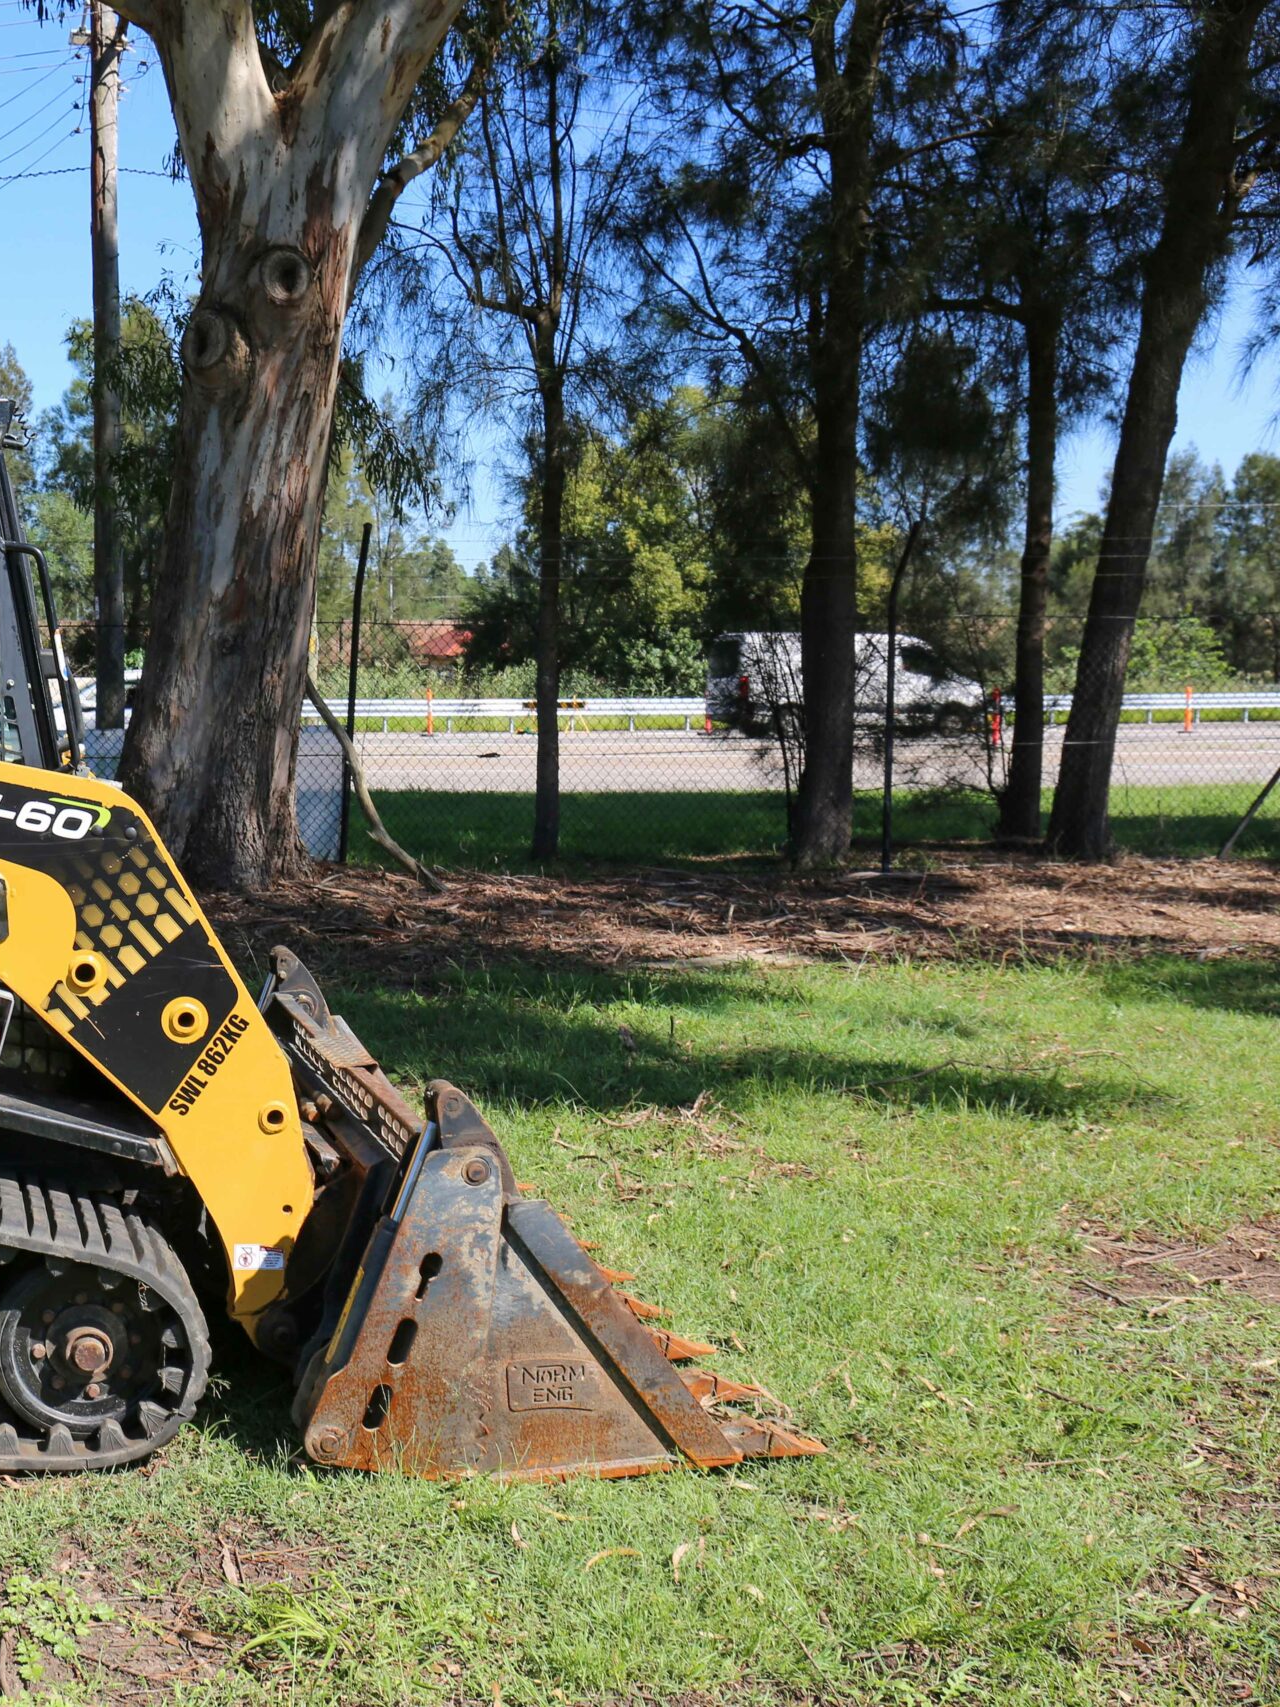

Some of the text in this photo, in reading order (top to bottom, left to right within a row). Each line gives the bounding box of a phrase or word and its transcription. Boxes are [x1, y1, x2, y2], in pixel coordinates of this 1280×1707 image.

[168, 1013, 251, 1117] SWL 862KG
[521, 1364, 585, 1385] NORM
[533, 1386, 573, 1403] ENG
